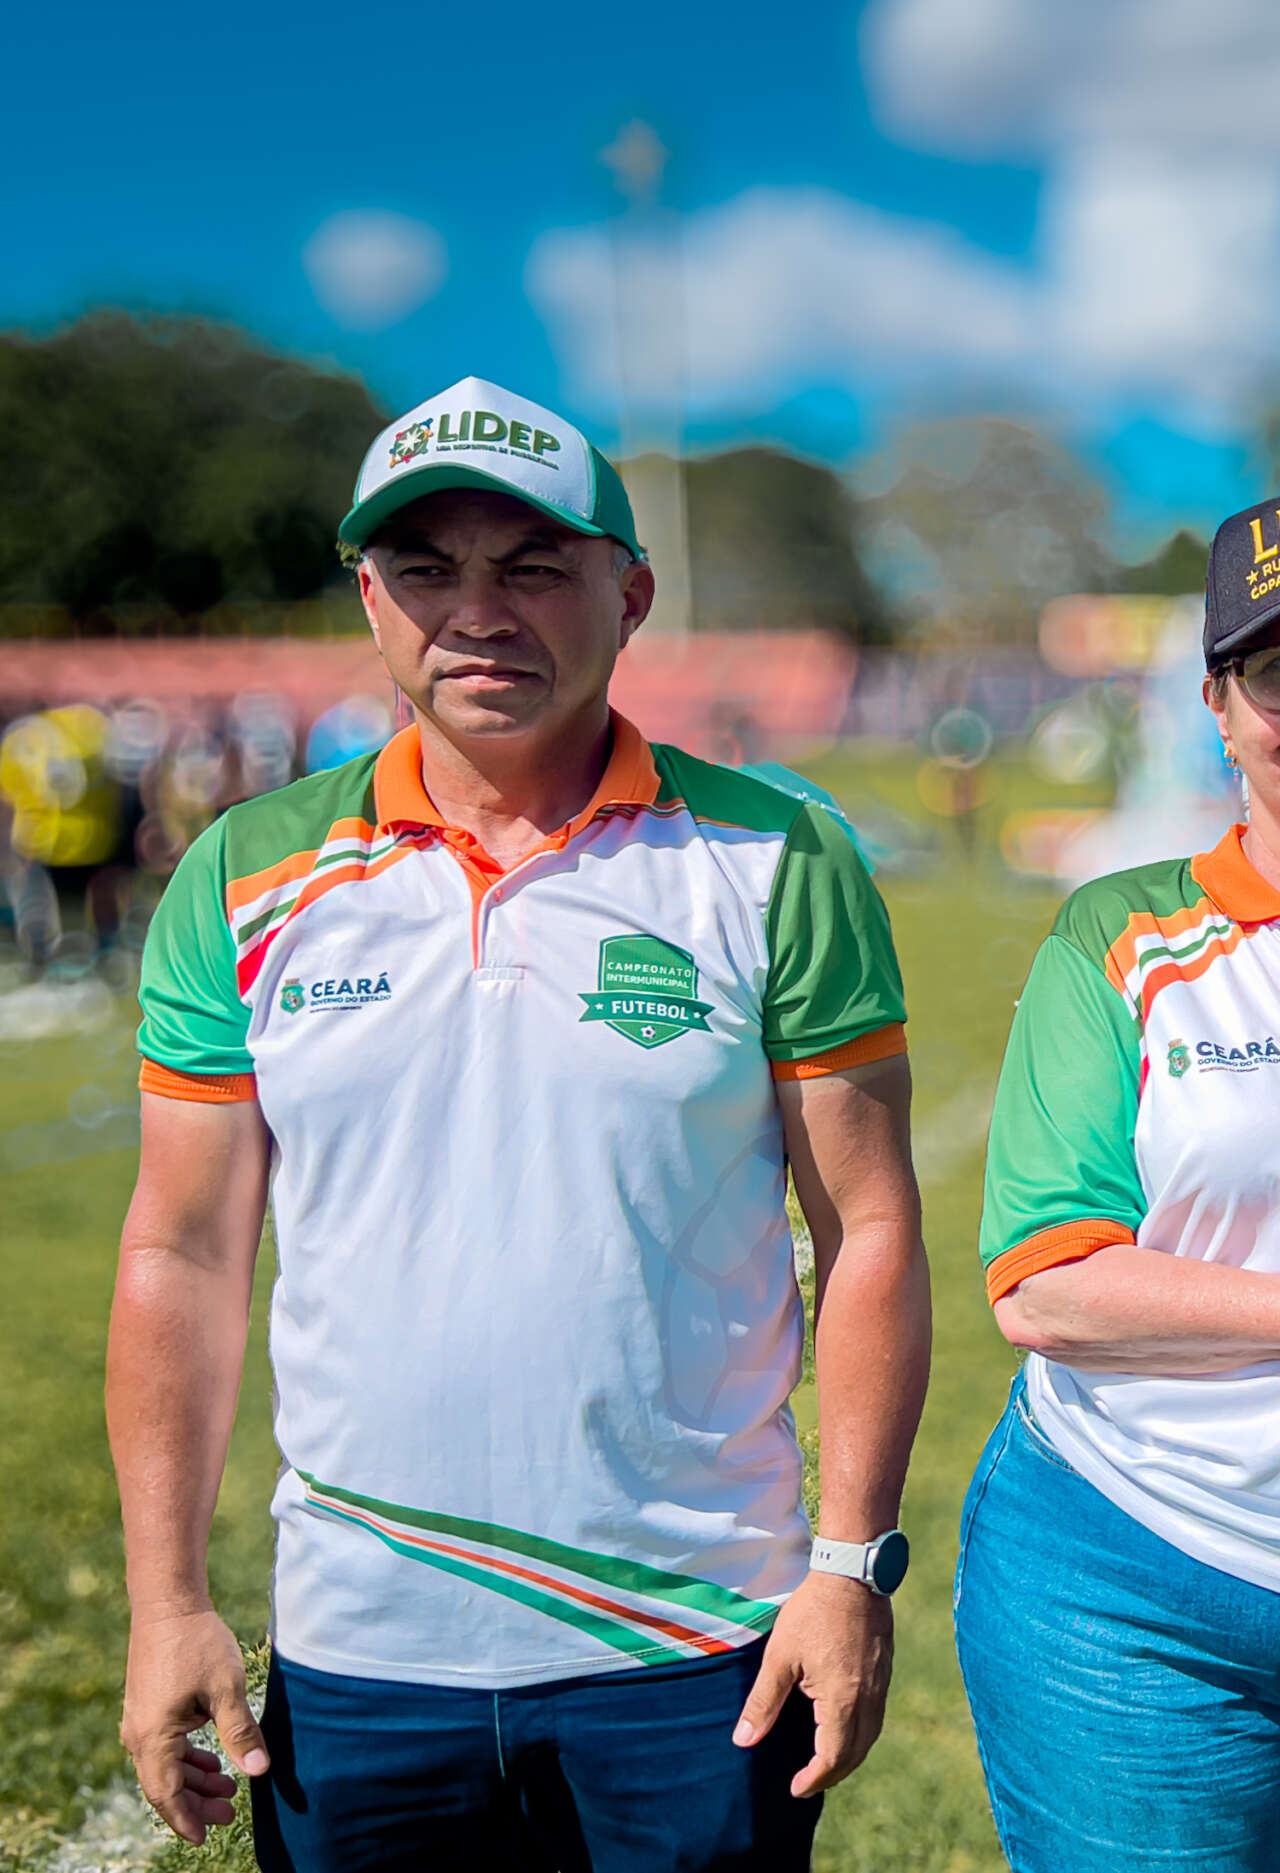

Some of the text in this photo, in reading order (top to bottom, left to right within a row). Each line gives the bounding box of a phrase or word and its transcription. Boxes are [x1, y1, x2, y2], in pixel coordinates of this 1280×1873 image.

[437, 411, 560, 455] LIDEP
[607, 962, 692, 978] CAMPEONATO
[310, 971, 392, 998] CEARÁ
[606, 973, 689, 989] INTERMUNICIPAL
[611, 1000, 689, 1020] FUTEBOL
[1197, 1057, 1238, 1067] GOVERNO
